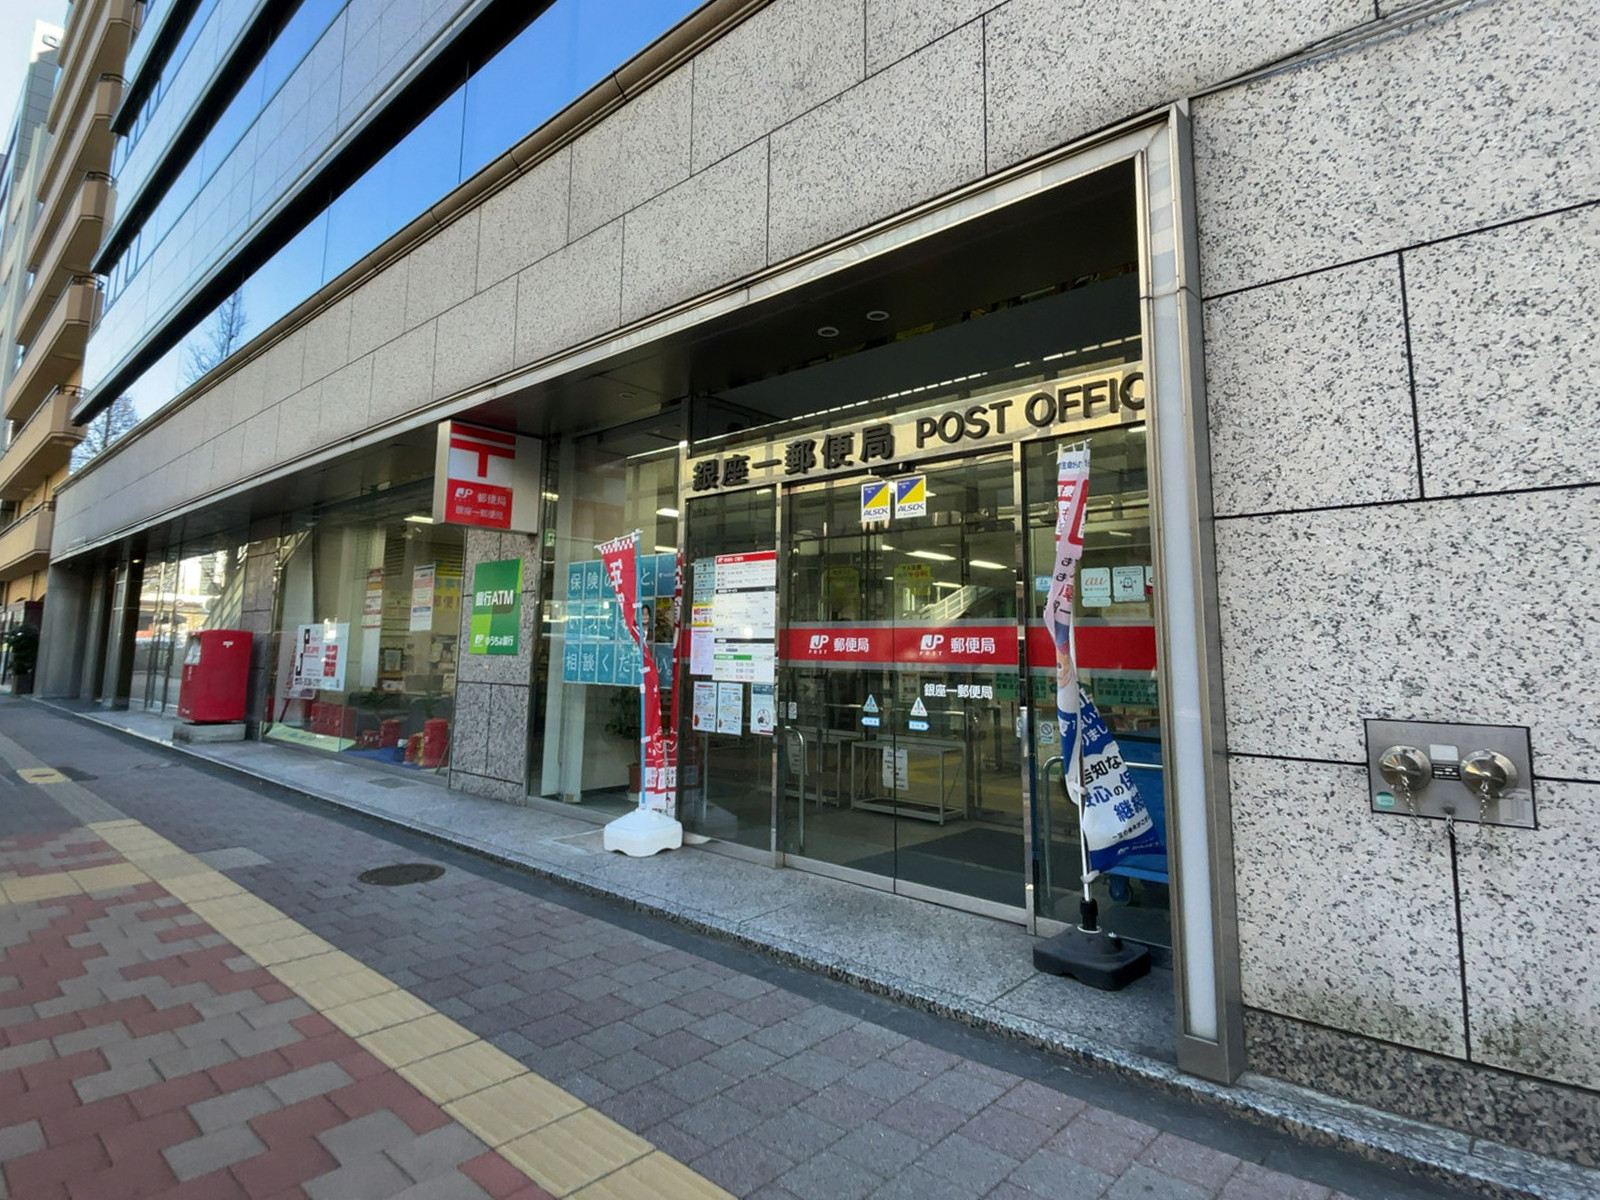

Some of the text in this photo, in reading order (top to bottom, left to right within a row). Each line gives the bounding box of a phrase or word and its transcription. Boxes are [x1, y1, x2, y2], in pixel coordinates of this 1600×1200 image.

[692, 372, 1145, 491] 銀座一郵便局 POST OFFIC
[864, 507, 888, 516] ALSOK
[897, 503, 924, 512] ALSOK
[475, 590, 514, 606] 銀行ATM
[833, 637, 870, 653] 郵便局
[950, 637, 996, 655] 郵便局
[924, 683, 994, 700] 銀座一郵便局
